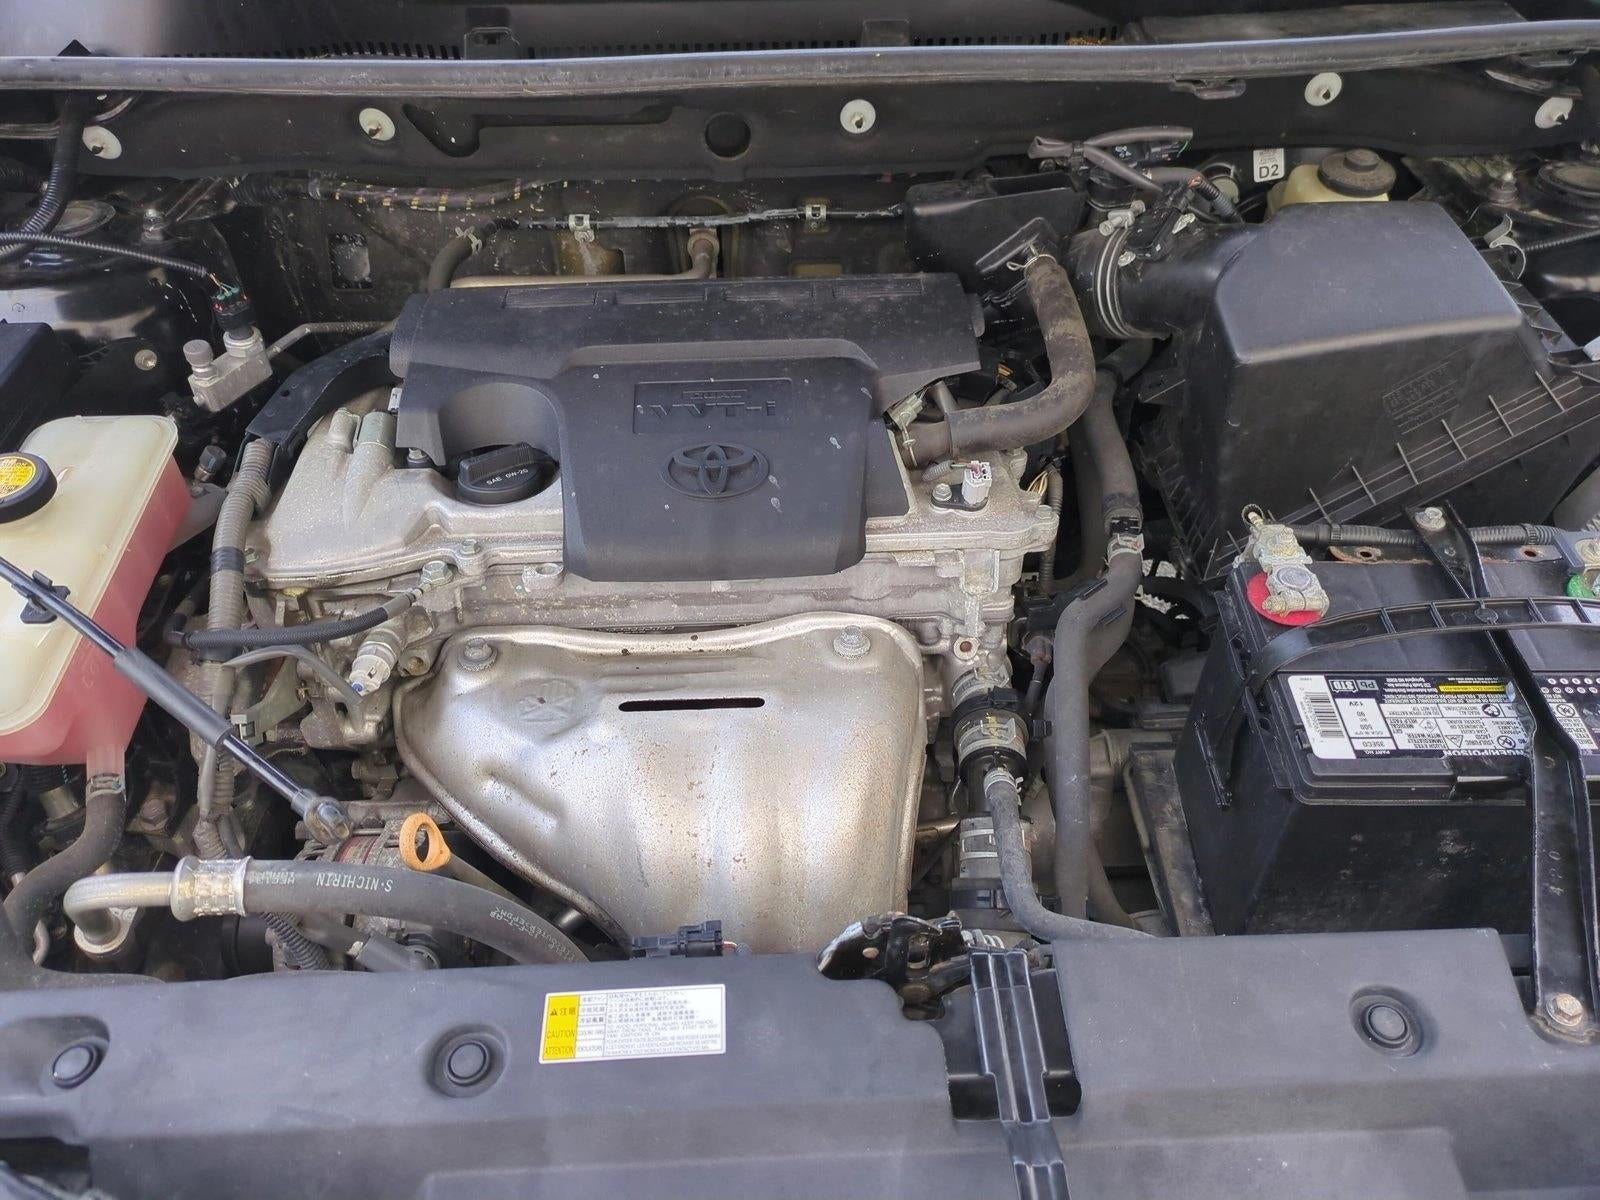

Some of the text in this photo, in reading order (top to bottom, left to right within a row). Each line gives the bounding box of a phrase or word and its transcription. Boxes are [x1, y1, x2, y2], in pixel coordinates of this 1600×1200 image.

[1259, 164, 1279, 178] D2
[486, 468, 529, 485] SAE 0W-20
[1360, 681, 1375, 689] Pb
[546, 1030, 575, 1040] CAUTION
[544, 1046, 574, 1056] ATTENTION
